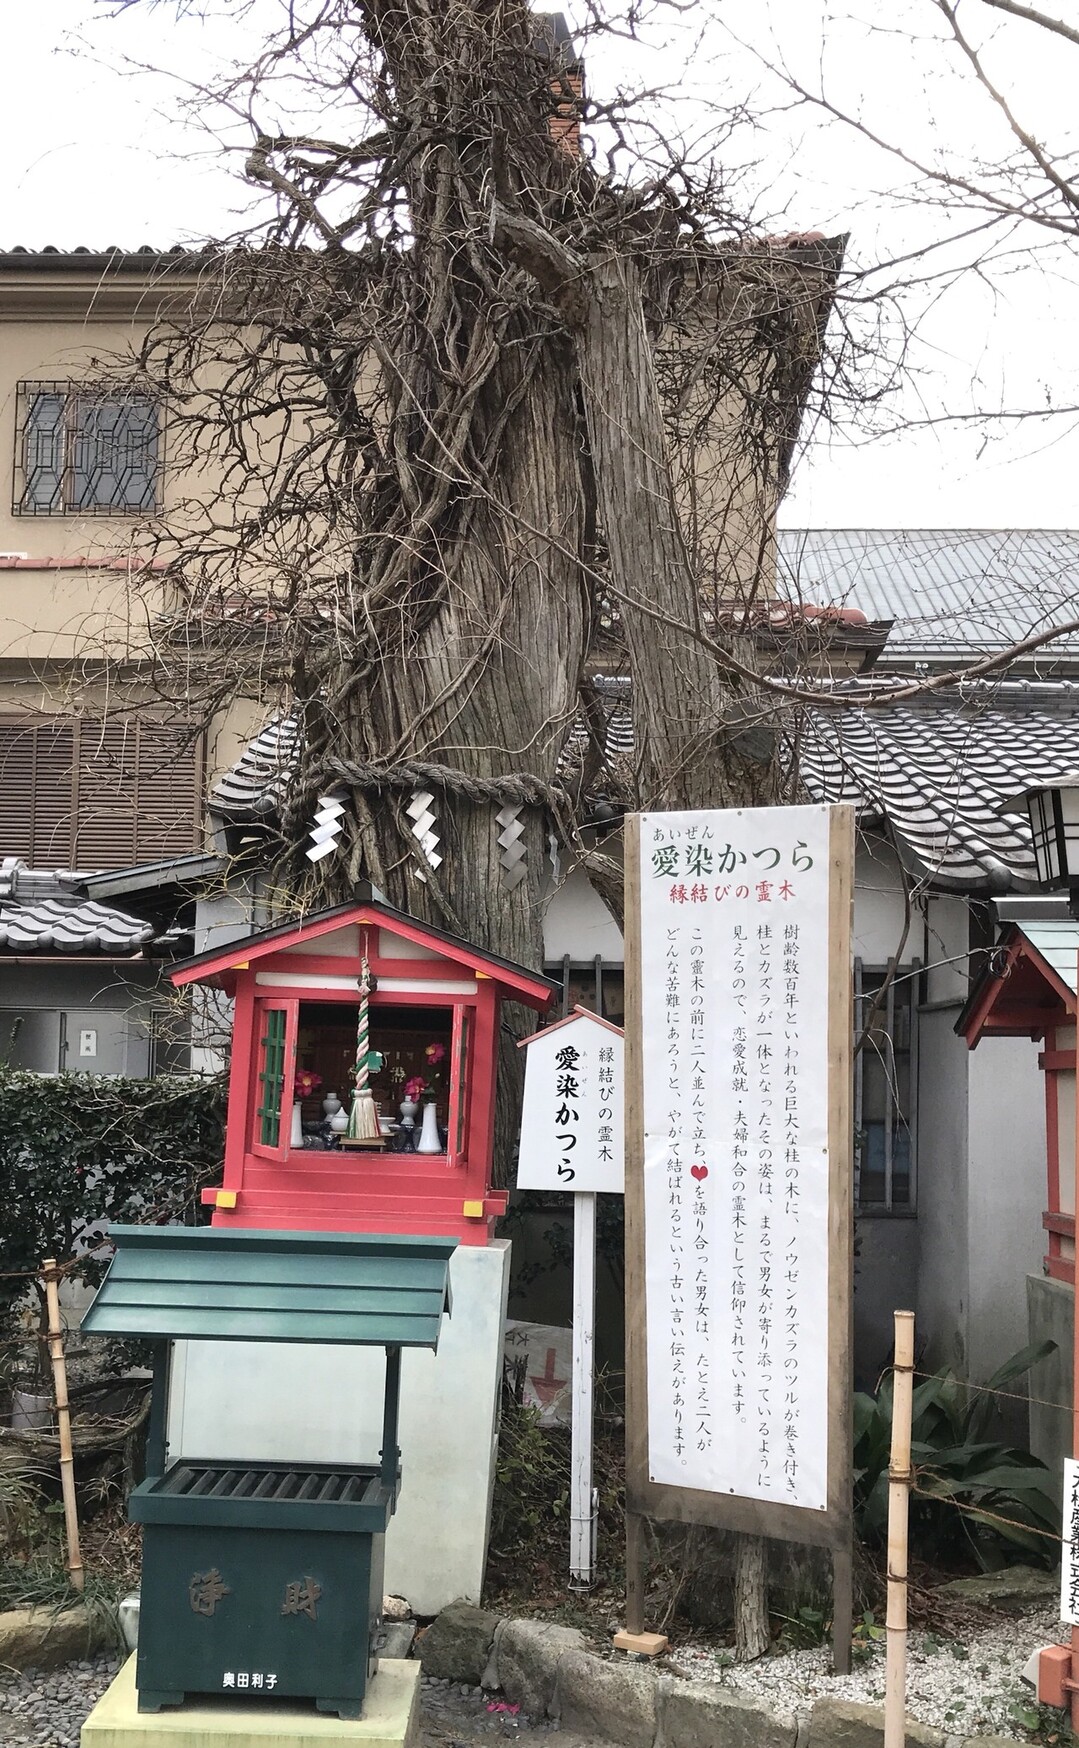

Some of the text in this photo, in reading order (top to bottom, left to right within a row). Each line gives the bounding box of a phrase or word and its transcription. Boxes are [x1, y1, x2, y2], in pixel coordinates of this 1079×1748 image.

[653, 825, 715, 840] あいぜん
[651, 838, 814, 879] 愛染かつら
[669, 879, 797, 904] 縁結びの霊木
[554, 1045, 580, 1183] 愛染かつら
[597, 1046, 615, 1163] 縁結びの霊木
[221, 1671, 279, 1690] 奥田利子
